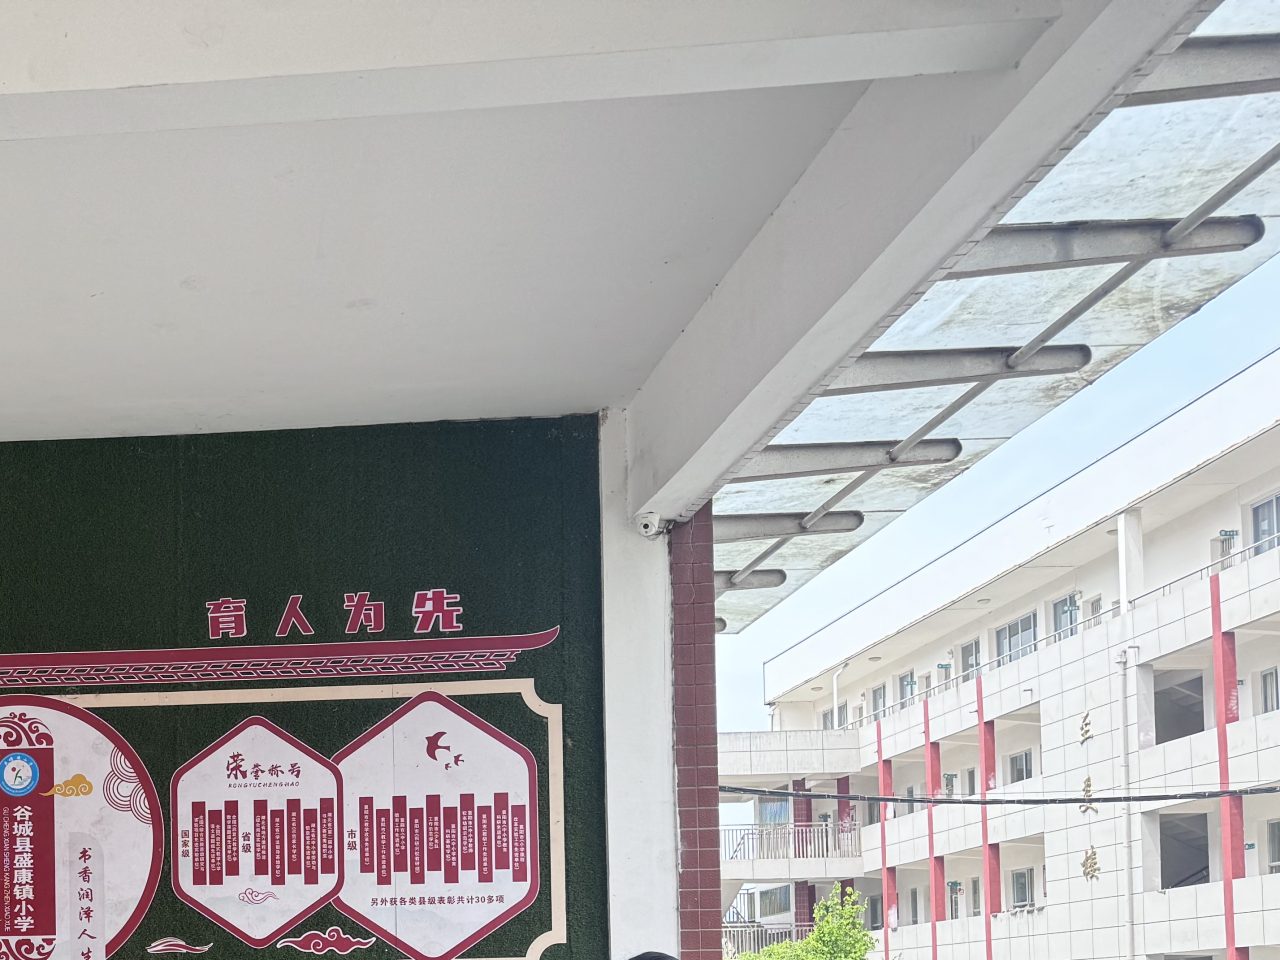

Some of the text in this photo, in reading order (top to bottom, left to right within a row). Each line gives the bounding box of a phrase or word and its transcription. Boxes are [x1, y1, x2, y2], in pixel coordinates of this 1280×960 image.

[206, 589, 463, 639] 育人为先
[226, 751, 301, 780] 荣誉称号
[181, 830, 190, 858] 国家级
[241, 831, 252, 853] 省级
[347, 828, 357, 851] 市级
[12, 805, 35, 932] 谷城县盛康镇小学
[370, 894, 505, 907] 另外获各类县级表彰共计30多项
